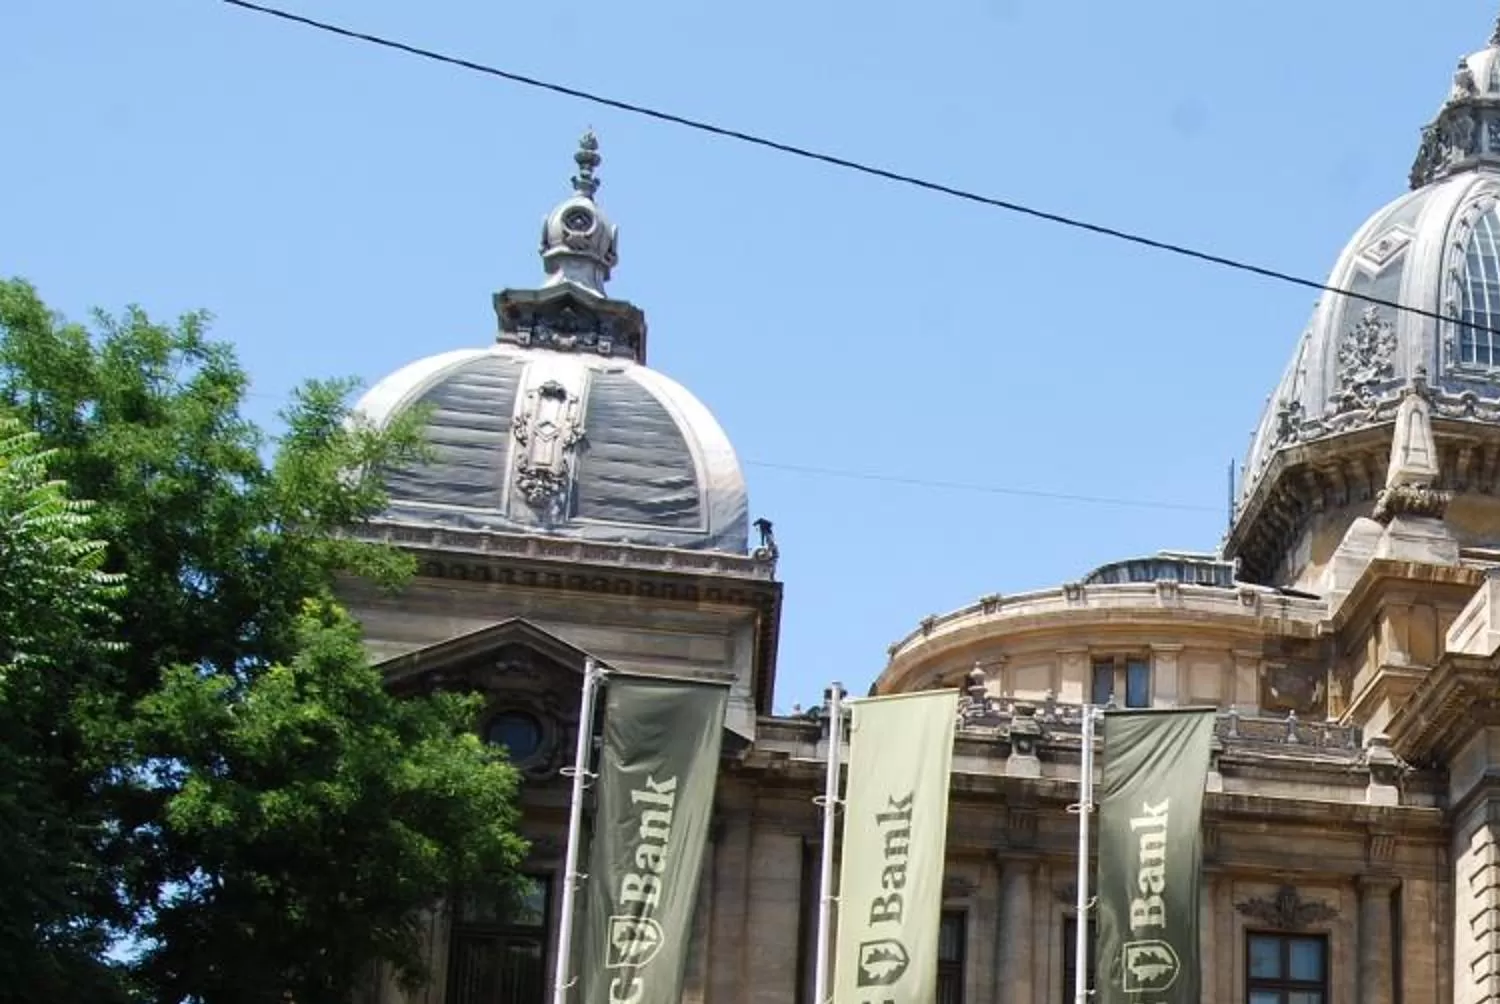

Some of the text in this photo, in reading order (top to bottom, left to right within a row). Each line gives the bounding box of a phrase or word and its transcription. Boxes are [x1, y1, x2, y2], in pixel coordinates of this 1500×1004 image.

[620, 775, 677, 908] Bank
[868, 790, 915, 928] Bank
[1130, 797, 1169, 931] Bank
